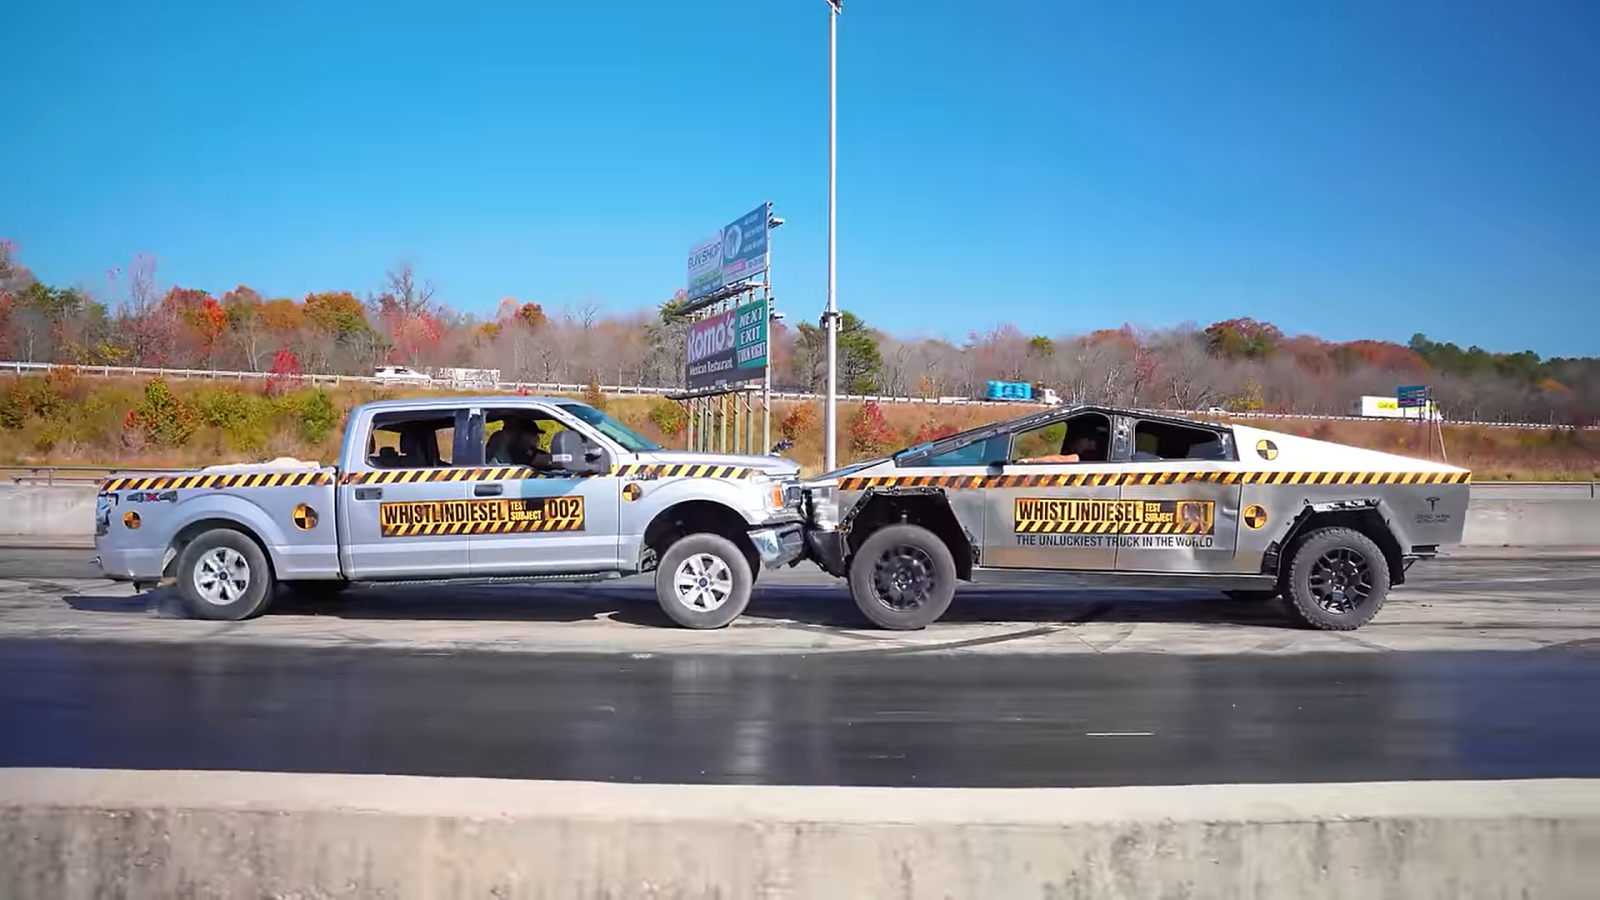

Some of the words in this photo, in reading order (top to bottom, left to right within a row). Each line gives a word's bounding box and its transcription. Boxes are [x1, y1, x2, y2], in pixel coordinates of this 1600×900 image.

[739, 306, 764, 329] NEXT
[740, 325, 762, 346] EXIT
[384, 501, 506, 525] WHISTLINDIESEL
[548, 499, 580, 519] 002
[511, 501, 527, 511] TEST
[1019, 501, 1140, 522] WHISTLINDIESEL
[1144, 502, 1161, 513] TEST
[510, 510, 542, 521] SUBJECT
[1144, 512, 1174, 522] SUBJECT
[1016, 534, 1036, 546] THE
[1039, 535, 1103, 547] UNLUCKIEST
[1105, 536, 1140, 548] TRUCK
[1142, 536, 1154, 548] IN
[1155, 536, 1174, 548] THE
